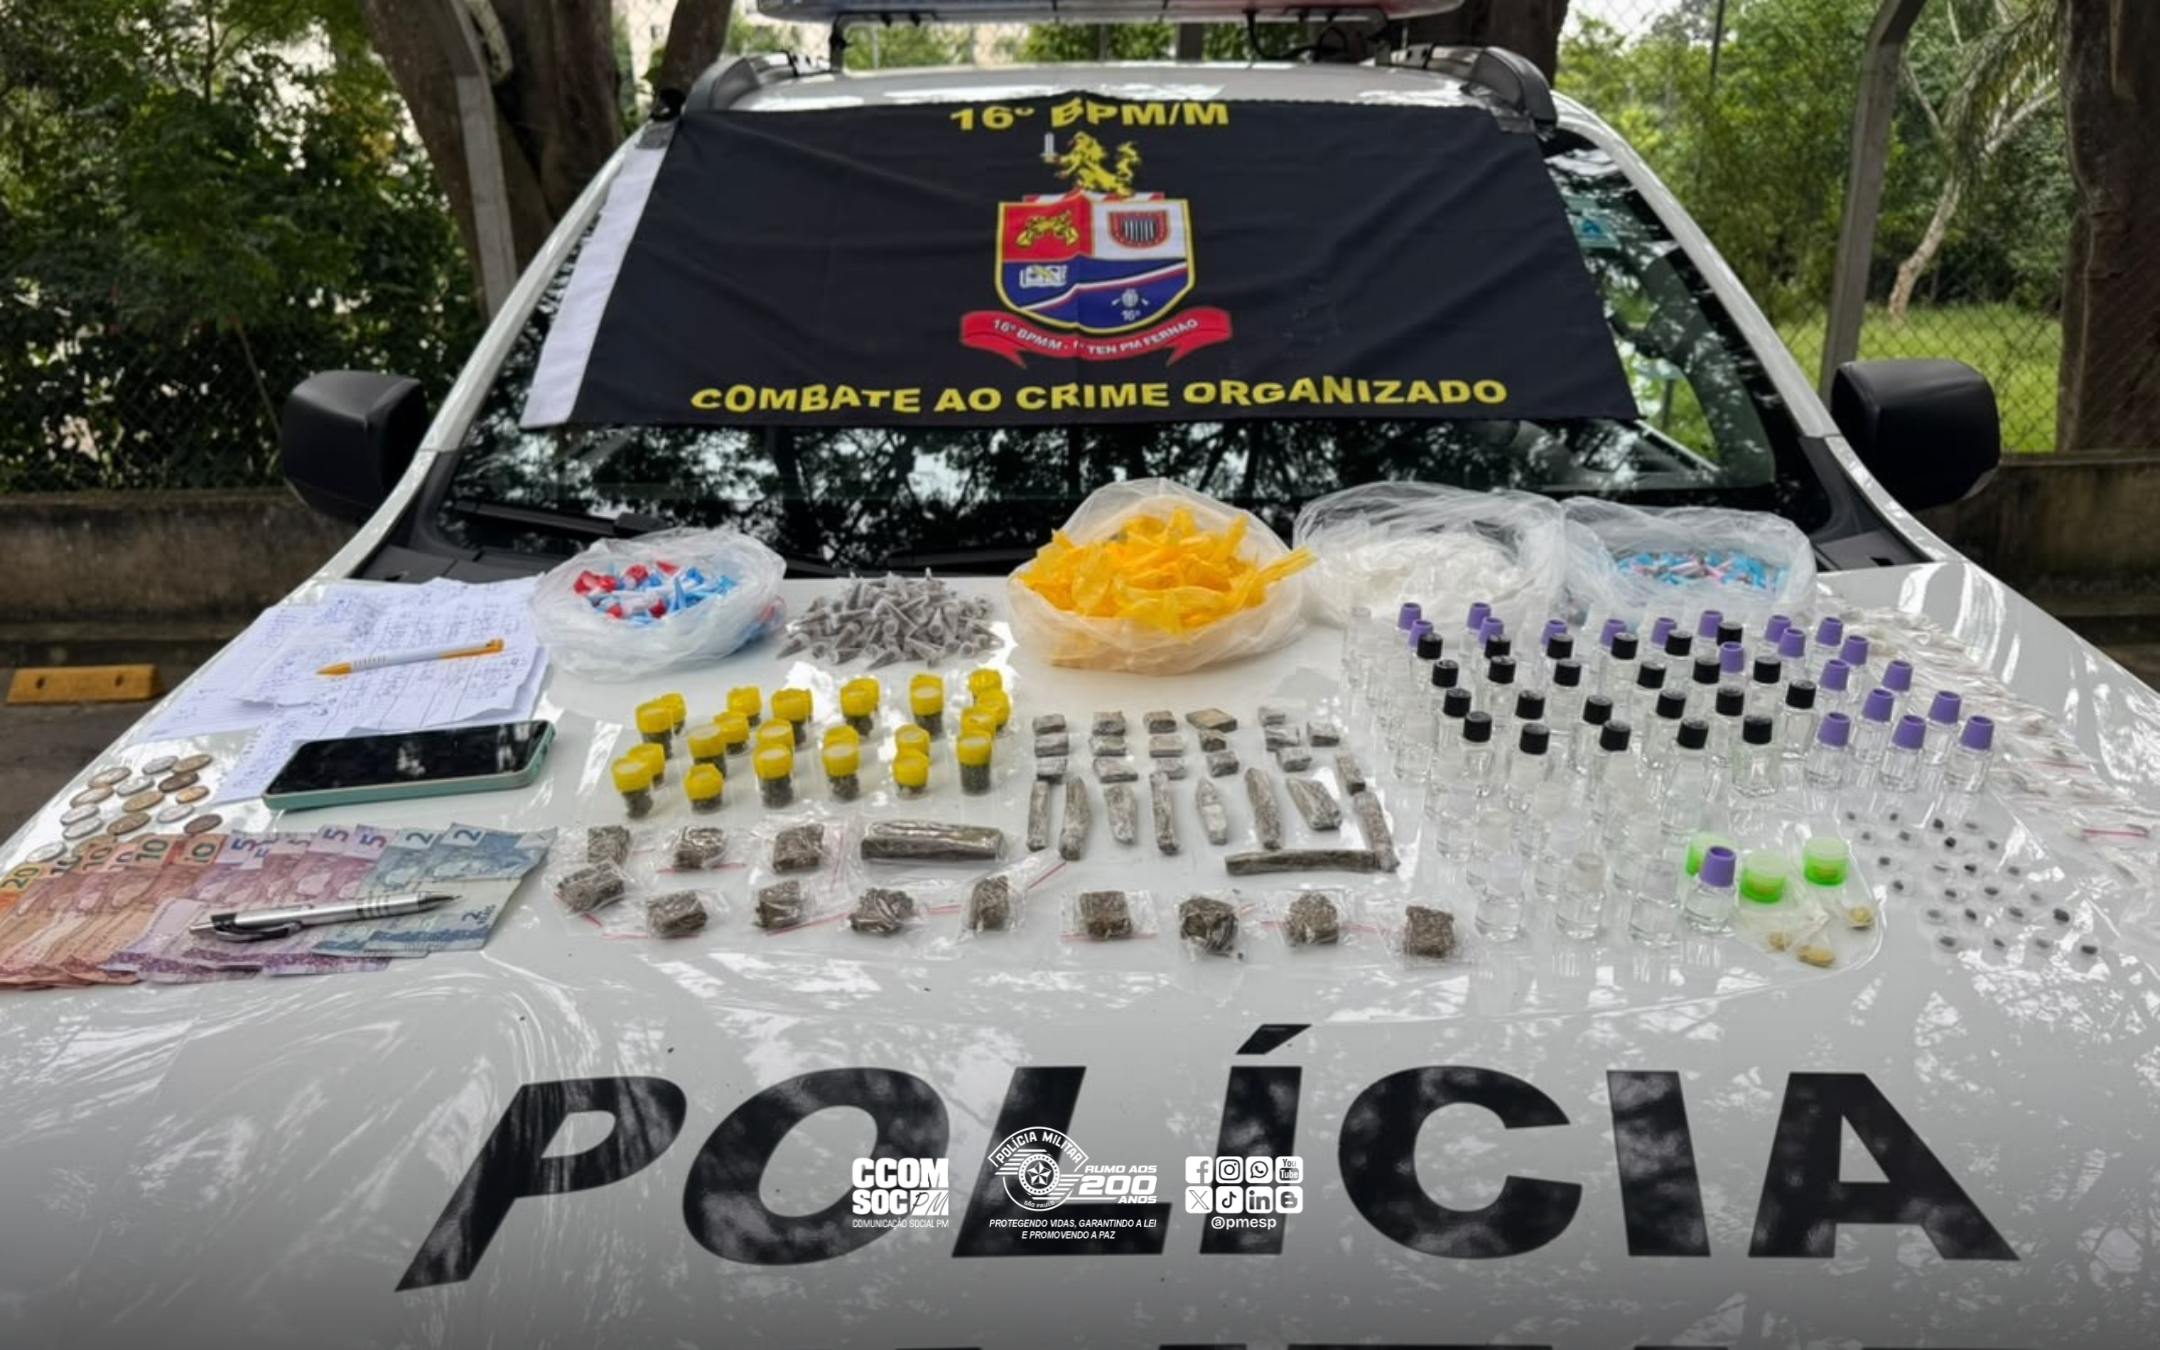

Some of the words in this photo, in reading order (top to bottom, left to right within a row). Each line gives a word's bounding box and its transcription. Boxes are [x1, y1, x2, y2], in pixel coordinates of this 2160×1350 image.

[1051, 97, 1230, 128] BPM/M
[1086, 344, 1118, 356] TEN
[1119, 339, 1143, 353] PM
[690, 383, 922, 413] COMBATE
[932, 387, 1002, 412] AO
[1015, 382, 1170, 409] CRIME
[1182, 375, 1508, 406] ORGANIZADO
[323, 828, 350, 842] 5
[359, 833, 387, 848] 5
[135, 838, 168, 862] 10
[1, 866, 39, 889] 20
[395, 1023, 2021, 1291] POLÍCIA
